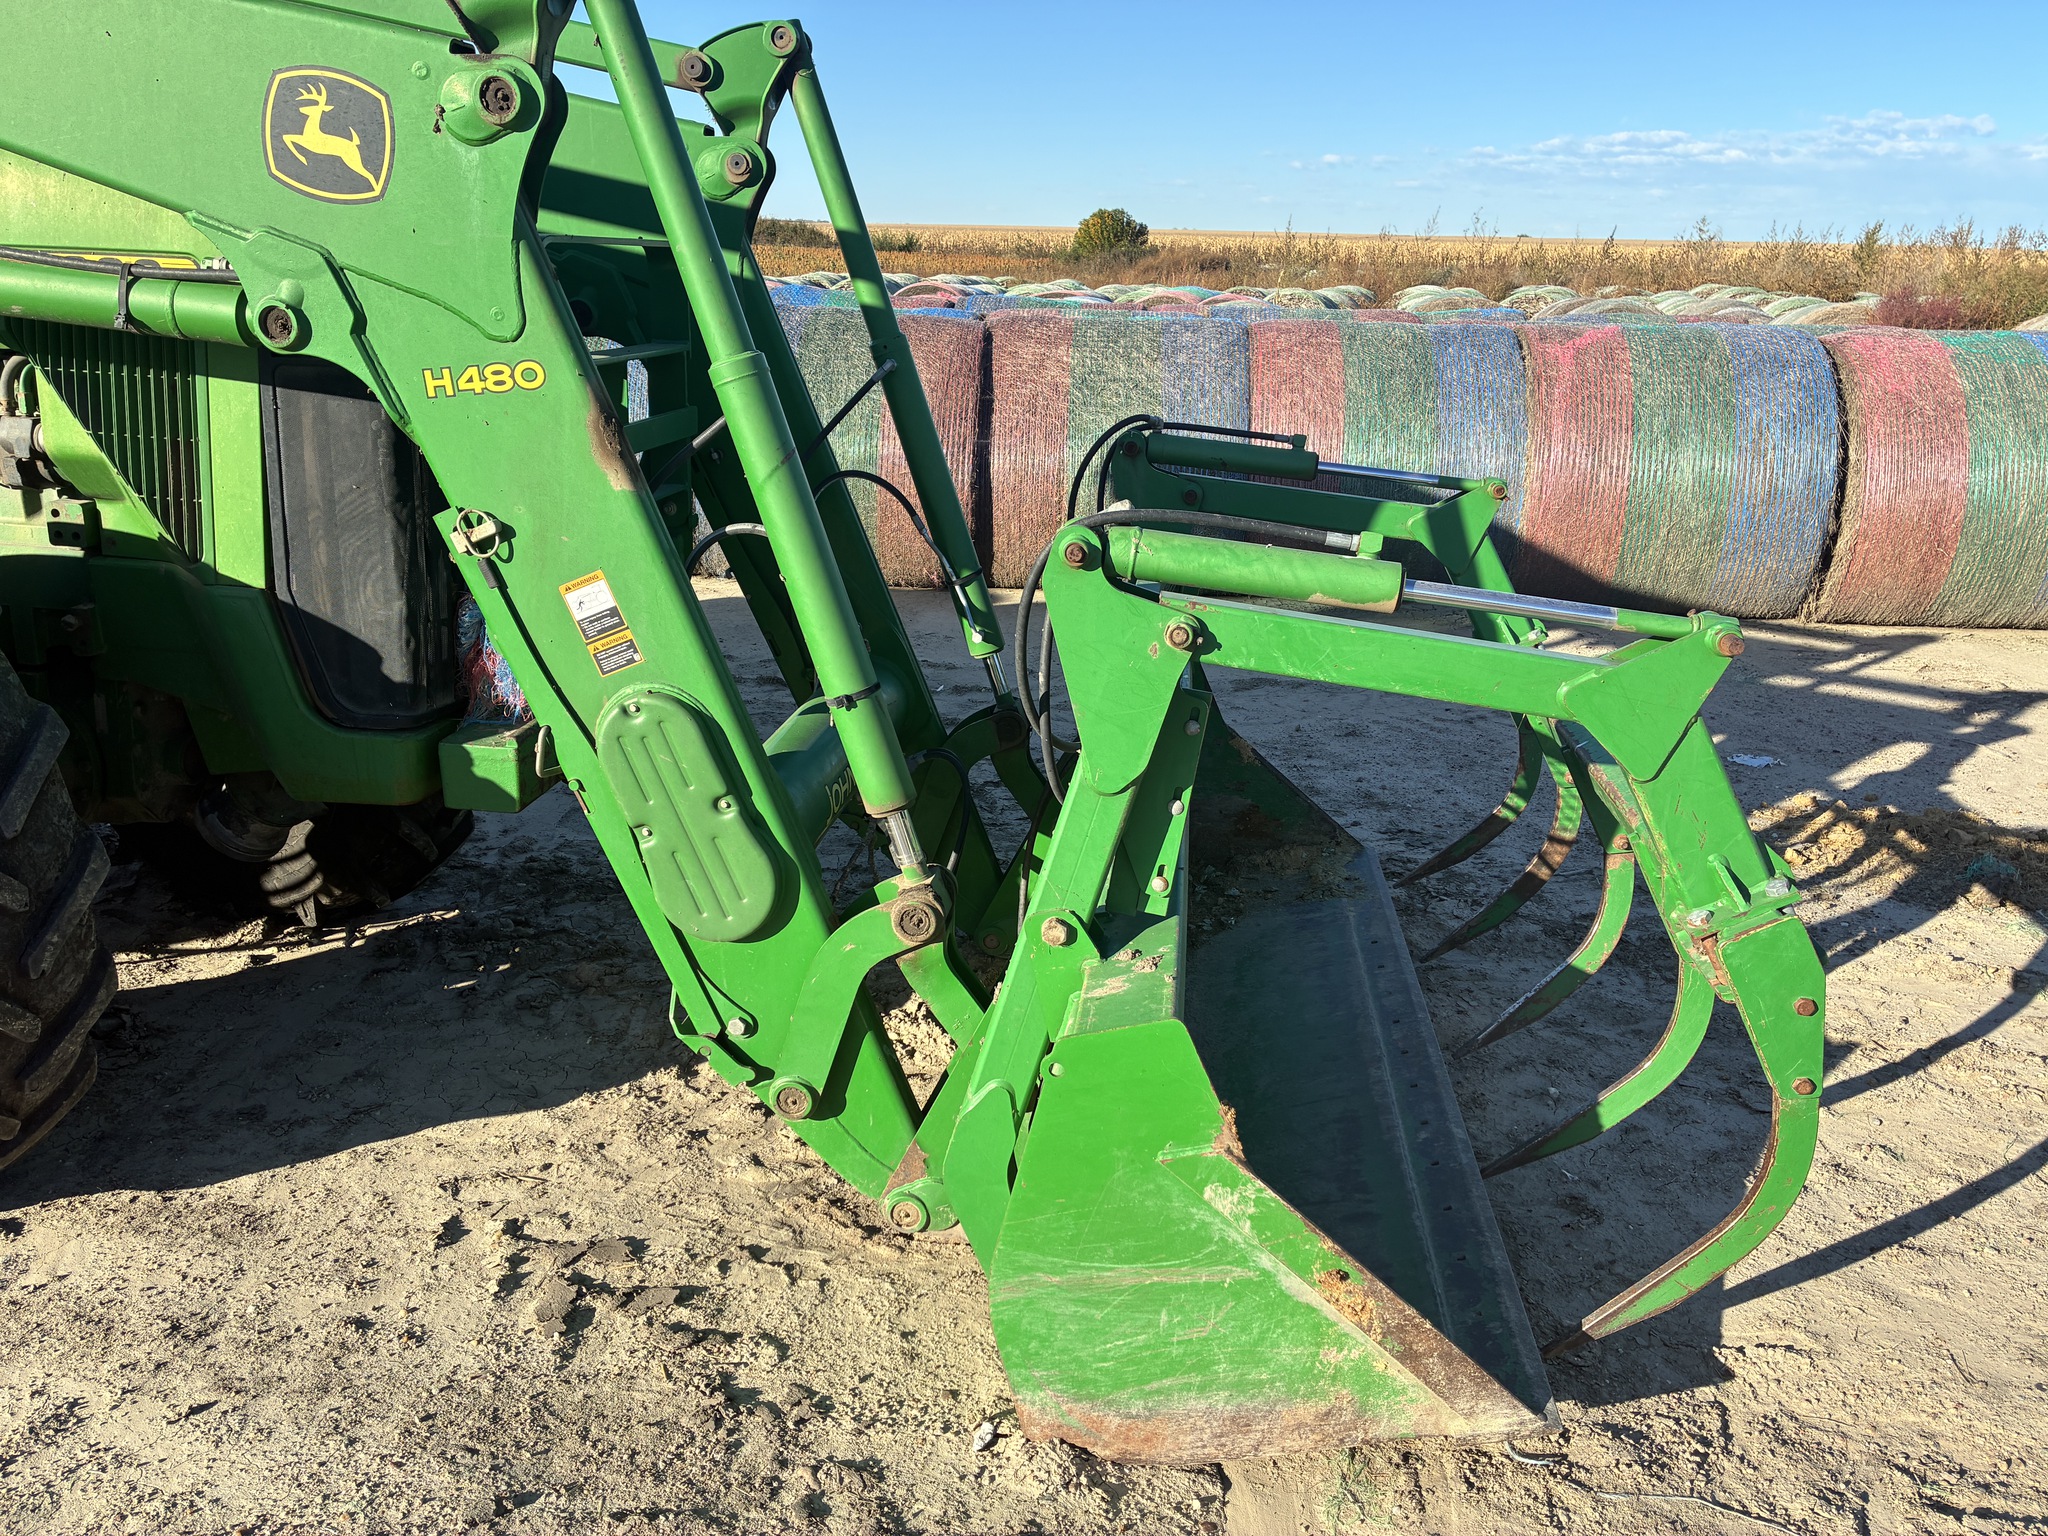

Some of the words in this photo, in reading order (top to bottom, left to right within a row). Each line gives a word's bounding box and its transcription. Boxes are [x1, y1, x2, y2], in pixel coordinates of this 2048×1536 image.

[422, 359, 547, 399] H480
[571, 574, 599, 589] WARNING
[600, 634, 628, 648] WARNING
